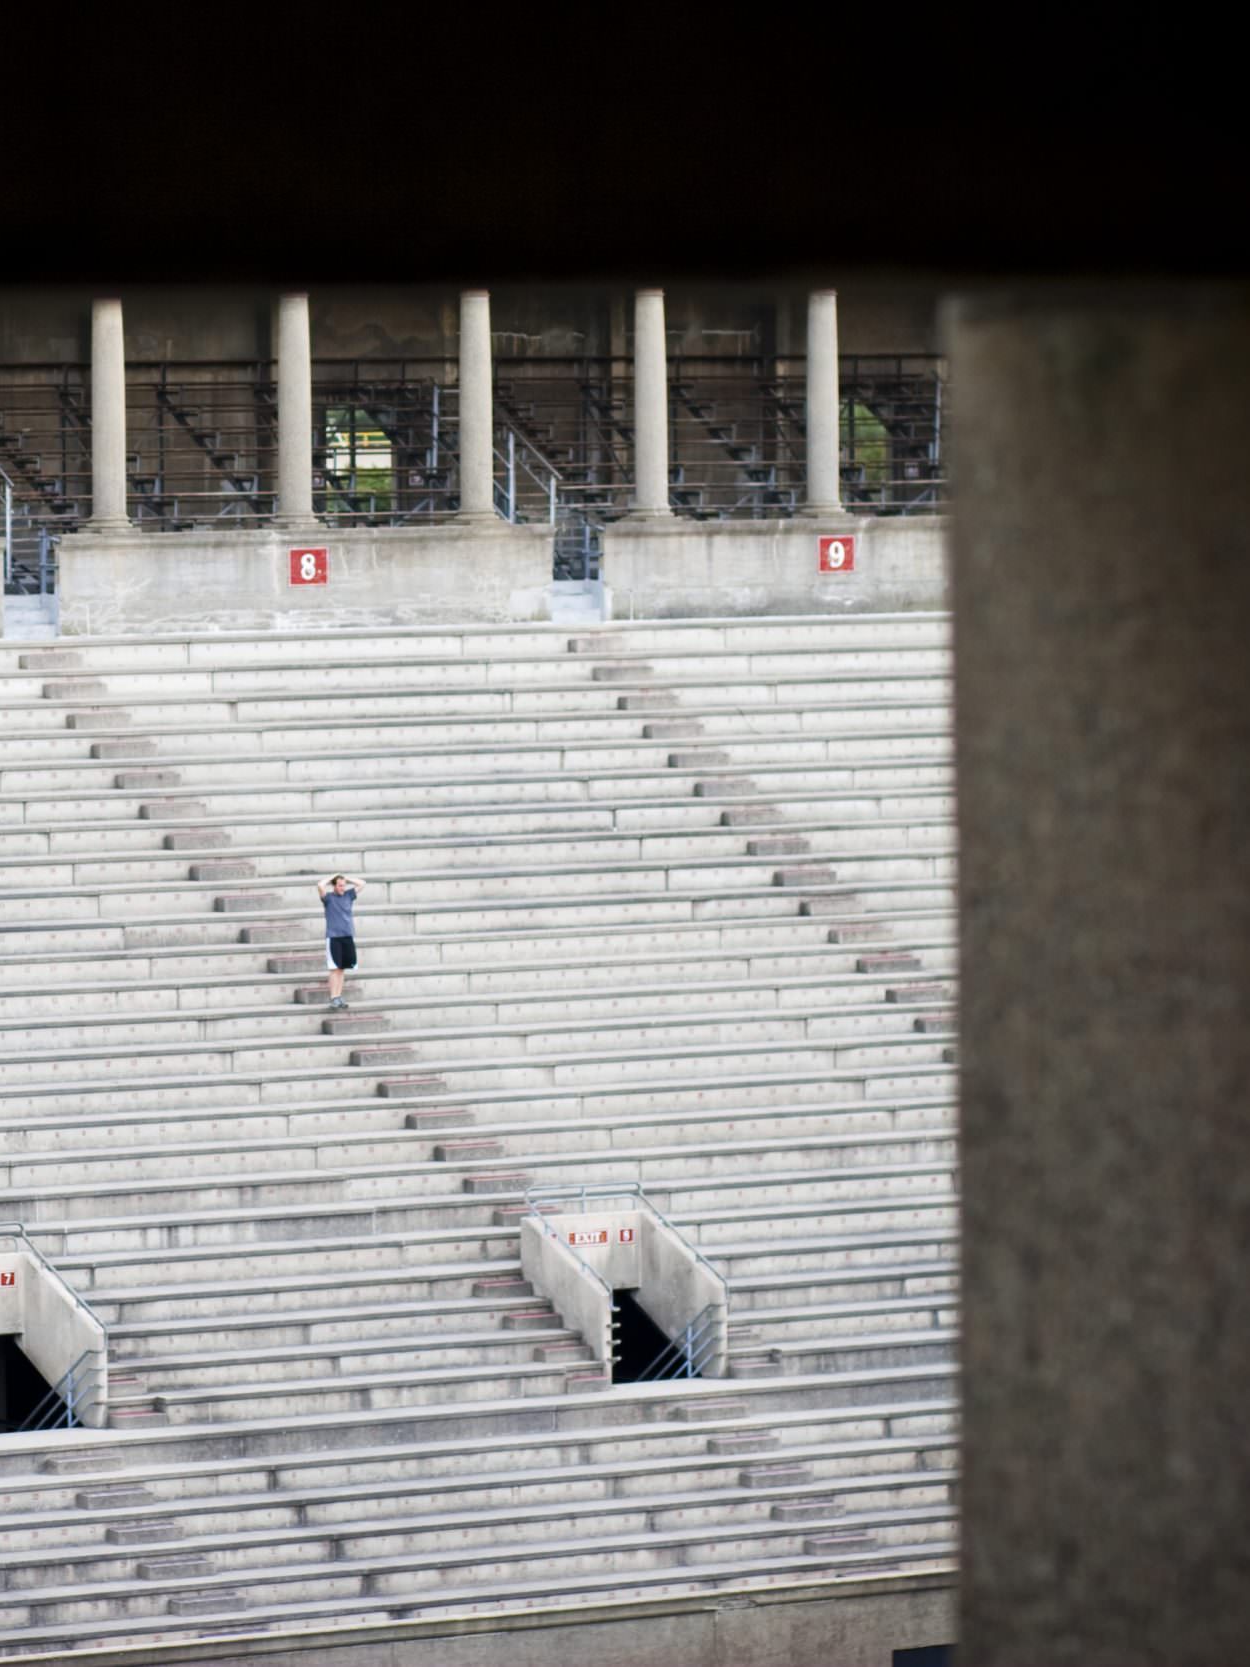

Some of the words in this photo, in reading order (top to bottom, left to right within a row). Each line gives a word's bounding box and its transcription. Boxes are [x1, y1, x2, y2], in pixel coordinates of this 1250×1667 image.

[829, 541, 845, 568] 9
[301, 553, 316, 580] 8
[575, 1232, 601, 1243] EXIT
[3, 1273, 11, 1284] 7
